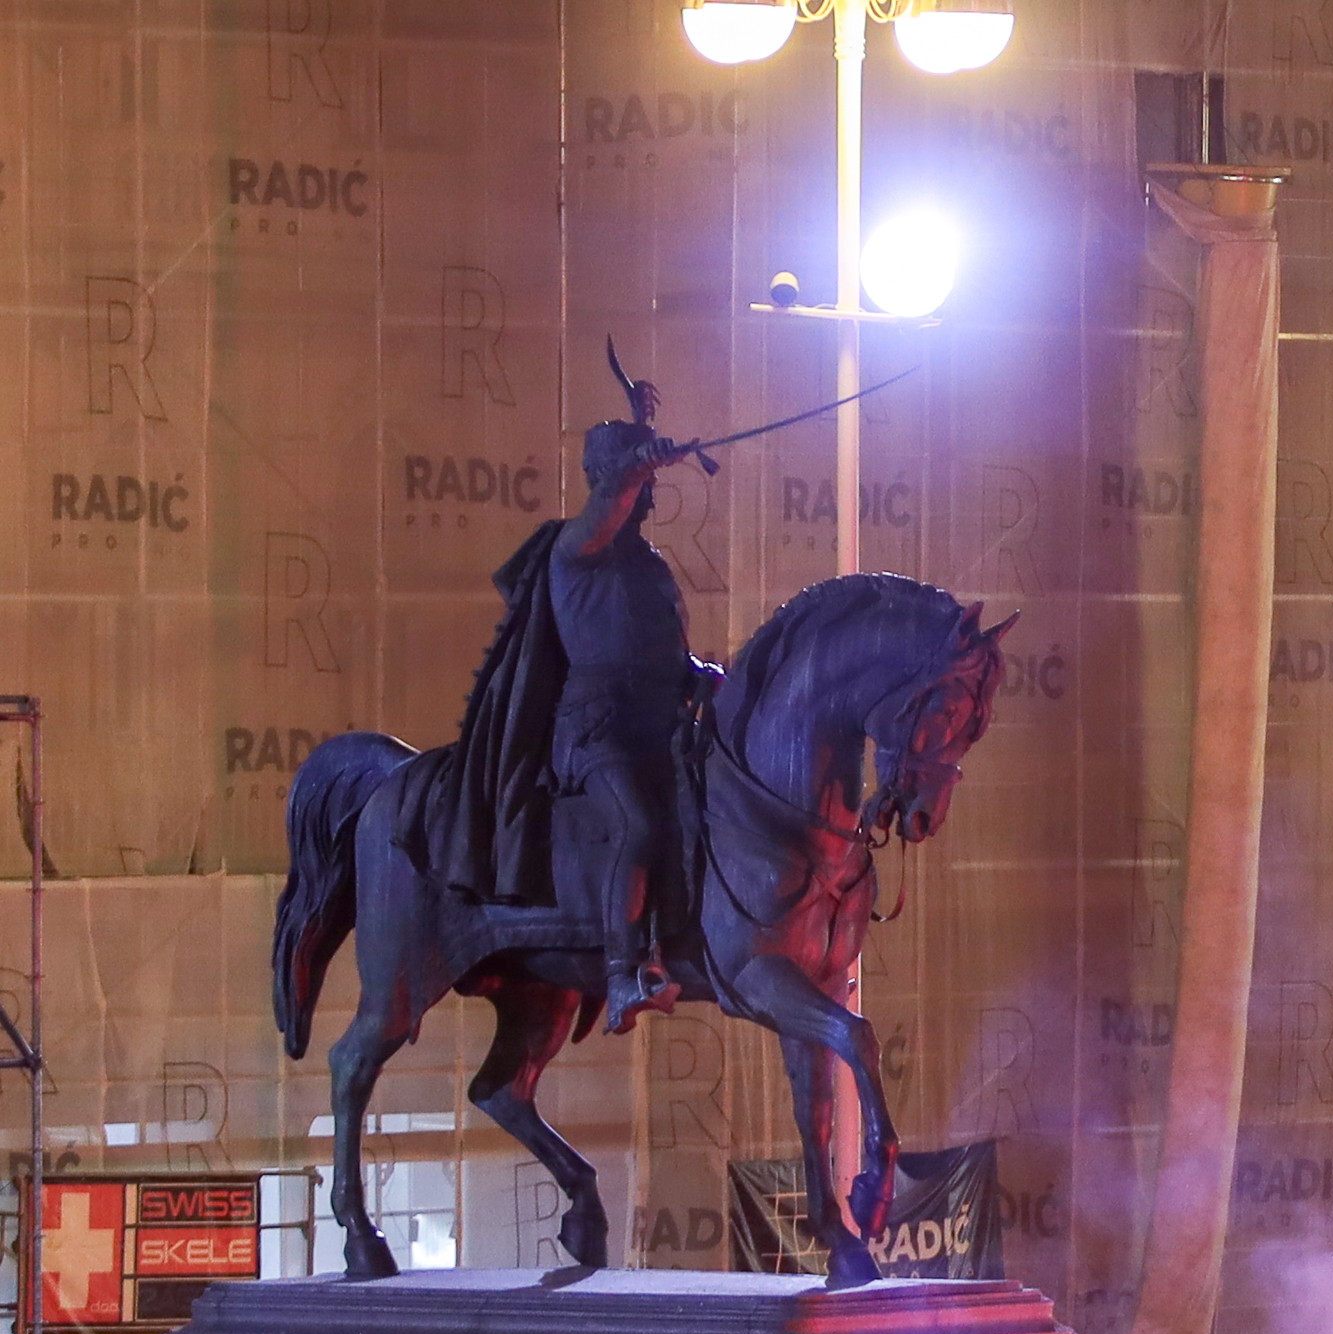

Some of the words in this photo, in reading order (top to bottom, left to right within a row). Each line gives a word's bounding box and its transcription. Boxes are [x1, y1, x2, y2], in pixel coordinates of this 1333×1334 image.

[228, 159, 369, 217] RADIĆ
[51, 471, 190, 533] RADIĆ
[404, 455, 543, 512] RADIĆ
[1100, 462, 1204, 515] RADI
[997, 642, 1068, 702] DIĆ
[1099, 996, 1173, 1046] RAD
[142, 1191, 252, 1218] SWISS
[141, 1238, 252, 1265] SKELE
[868, 1203, 971, 1264] RADIĆ
